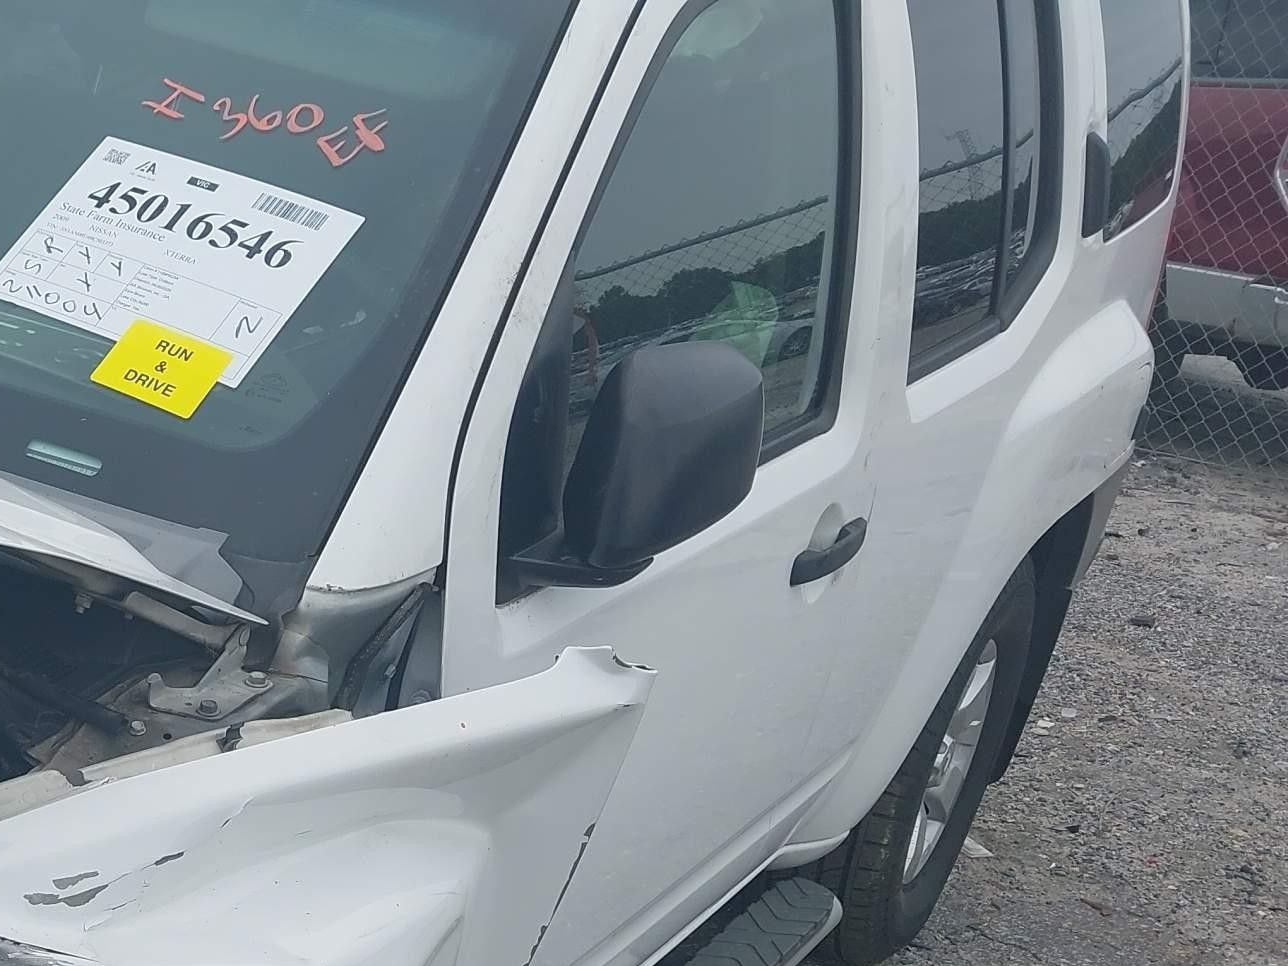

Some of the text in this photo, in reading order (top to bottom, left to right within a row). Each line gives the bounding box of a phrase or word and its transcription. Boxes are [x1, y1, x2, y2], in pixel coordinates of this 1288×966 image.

[213, 93, 325, 140] 360
[60, 201, 86, 216] State
[86, 210, 114, 225] Farm
[115, 217, 167, 242] Insurance
[87, 180, 305, 269] 45016546
[89, 224, 120, 239] NISSAN
[163, 248, 197, 265] XTERRA
[155, 339, 194, 362] RUN
[154, 360, 168, 374] &
[123, 368, 177, 398] DRIVE
